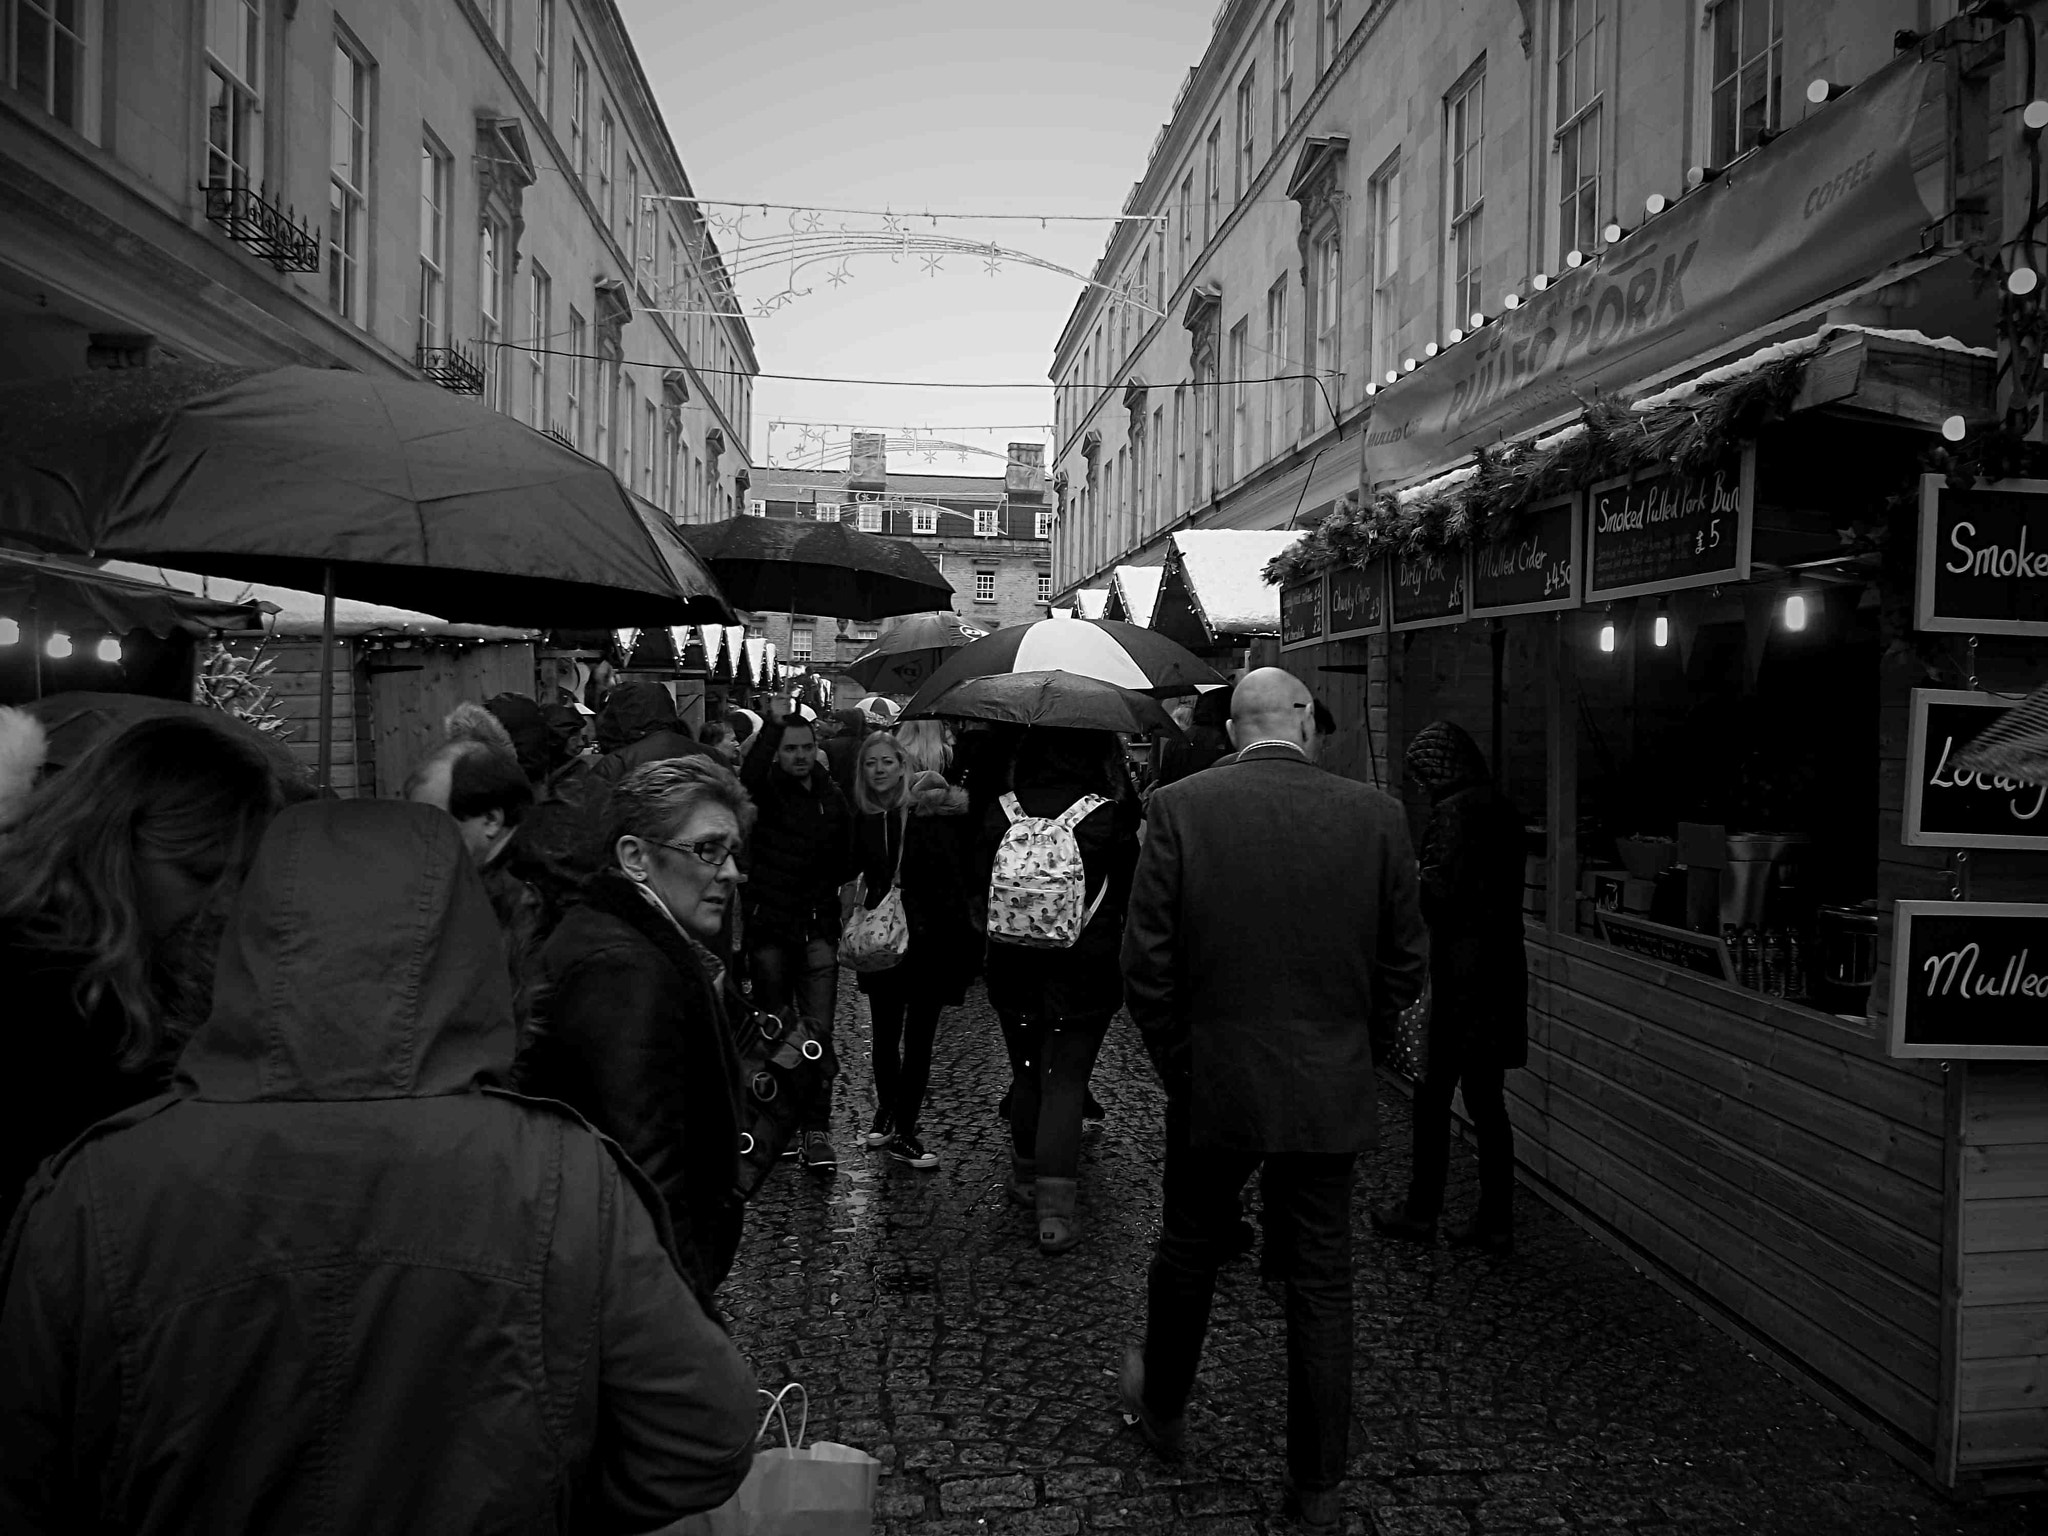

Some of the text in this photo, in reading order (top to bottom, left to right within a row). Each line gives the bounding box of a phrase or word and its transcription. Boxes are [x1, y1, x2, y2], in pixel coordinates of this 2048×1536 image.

[1803, 149, 1876, 219] COFFEE
[1556, 239, 1699, 372] PORK
[1598, 495, 1645, 533] Smoked
[1646, 485, 1678, 523] Pulled
[1710, 469, 1739, 513] Bun
[1478, 535, 1547, 580] Mulled Cider
[1695, 518, 1721, 554] £5
[1945, 521, 2048, 578] Smoke
[1400, 563, 1421, 596] Dirty
